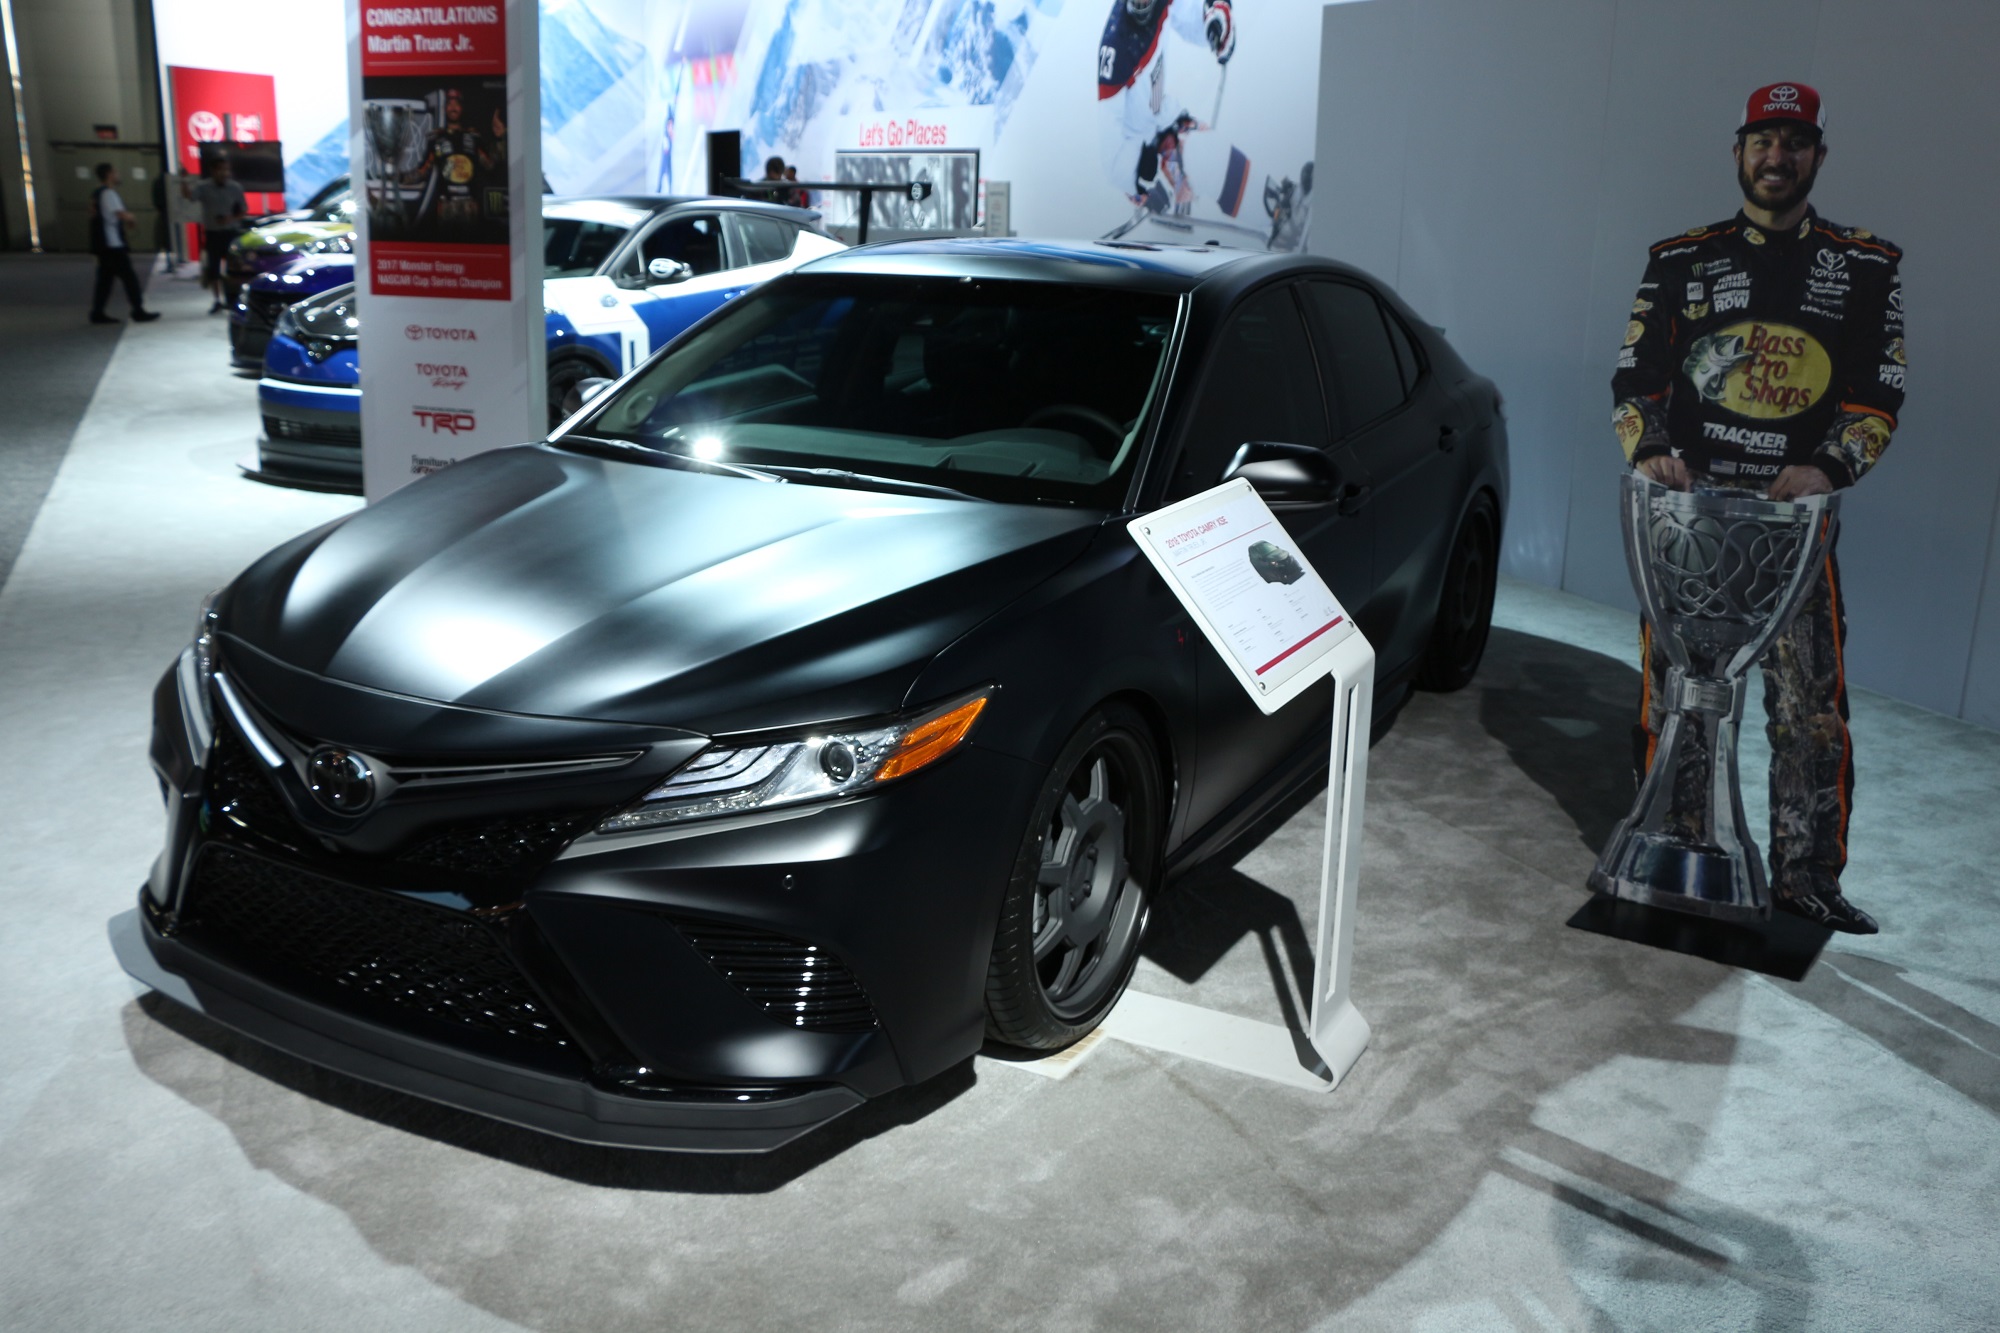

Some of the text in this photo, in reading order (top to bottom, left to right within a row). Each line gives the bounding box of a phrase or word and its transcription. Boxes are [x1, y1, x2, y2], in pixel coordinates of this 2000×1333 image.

[366, 5, 498, 27] CONGRATULATIONS
[367, 32, 475, 53] Martin Truex Jr.
[1762, 102, 1802, 113] TOYOTA
[859, 118, 947, 147] Let's Go Places
[377, 259, 465, 275] 2017 Monster Energy
[1810, 266, 1850, 281] TOYOTA
[377, 274, 503, 290] NASCAR Cup Series Champion
[1714, 297, 1750, 313] ROW
[424, 327, 478, 341] TOYOTA
[1744, 323, 1806, 358] Bass
[415, 363, 469, 378] TOYOTA
[1742, 353, 1789, 380] Pro
[1739, 376, 1812, 414] Shops
[412, 410, 476, 435] TRD
[1703, 422, 1788, 449] TRACKER
[1739, 463, 1781, 475] TRUEX
[1178, 528, 1201, 543] TOYOTA
[1197, 520, 1218, 535] CAMRY
